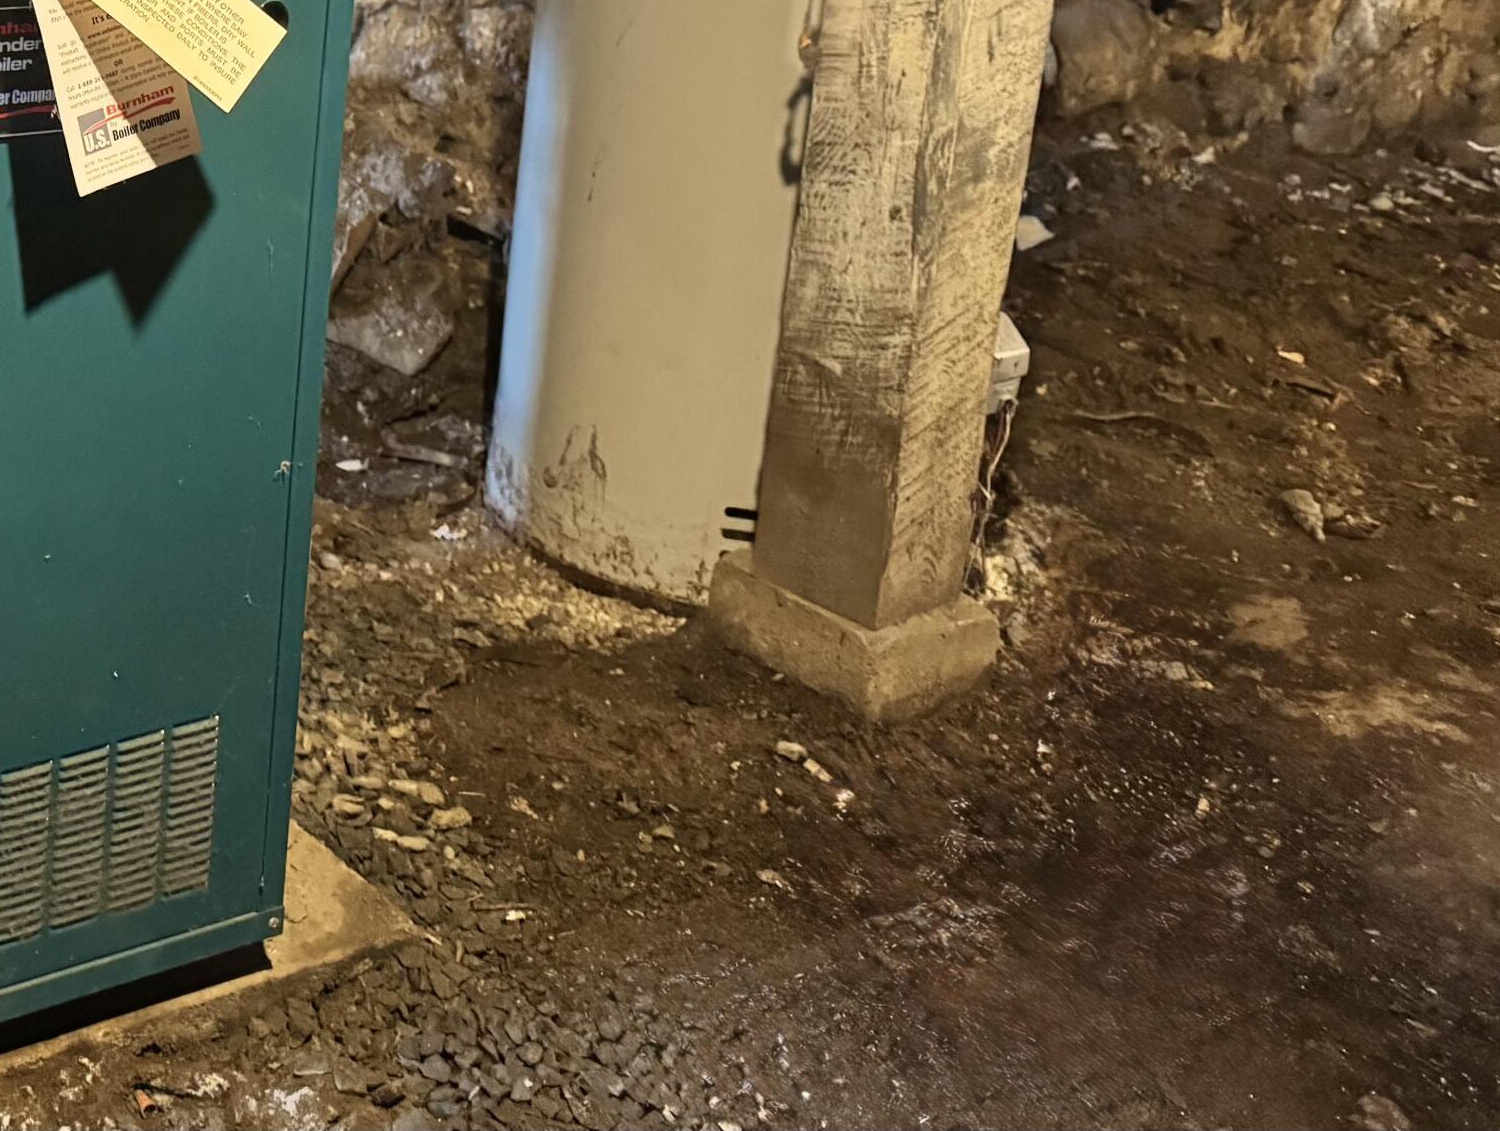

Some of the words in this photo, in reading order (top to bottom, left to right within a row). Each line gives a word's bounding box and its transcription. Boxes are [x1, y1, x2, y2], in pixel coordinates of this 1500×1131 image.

[193, 13, 220, 38] BOILER
[219, 35, 227, 44] IS
[205, 0, 231, 25] WHERE
[230, 22, 248, 38] SAW
[220, 2, 245, 25] OTHER
[160, 8, 176, 23] AND
[179, 22, 204, 47] PORTS
[206, 47, 228, 66] MUST
[230, 66, 242, 78] BE
[220, 25, 237, 40] DRY
[237, 38, 255, 58] WALL
[176, 31, 197, 51] DAILY
[198, 50, 209, 62] TO
[209, 60, 236, 85] INSURE
[232, 56, 246, 72] THE
[12, 88, 55, 105] Compa
[106, 86, 174, 115] Burnham
[83, 128, 110, 153] U.S.
[112, 124, 139, 141] Boiler
[138, 109, 181, 131] Company
